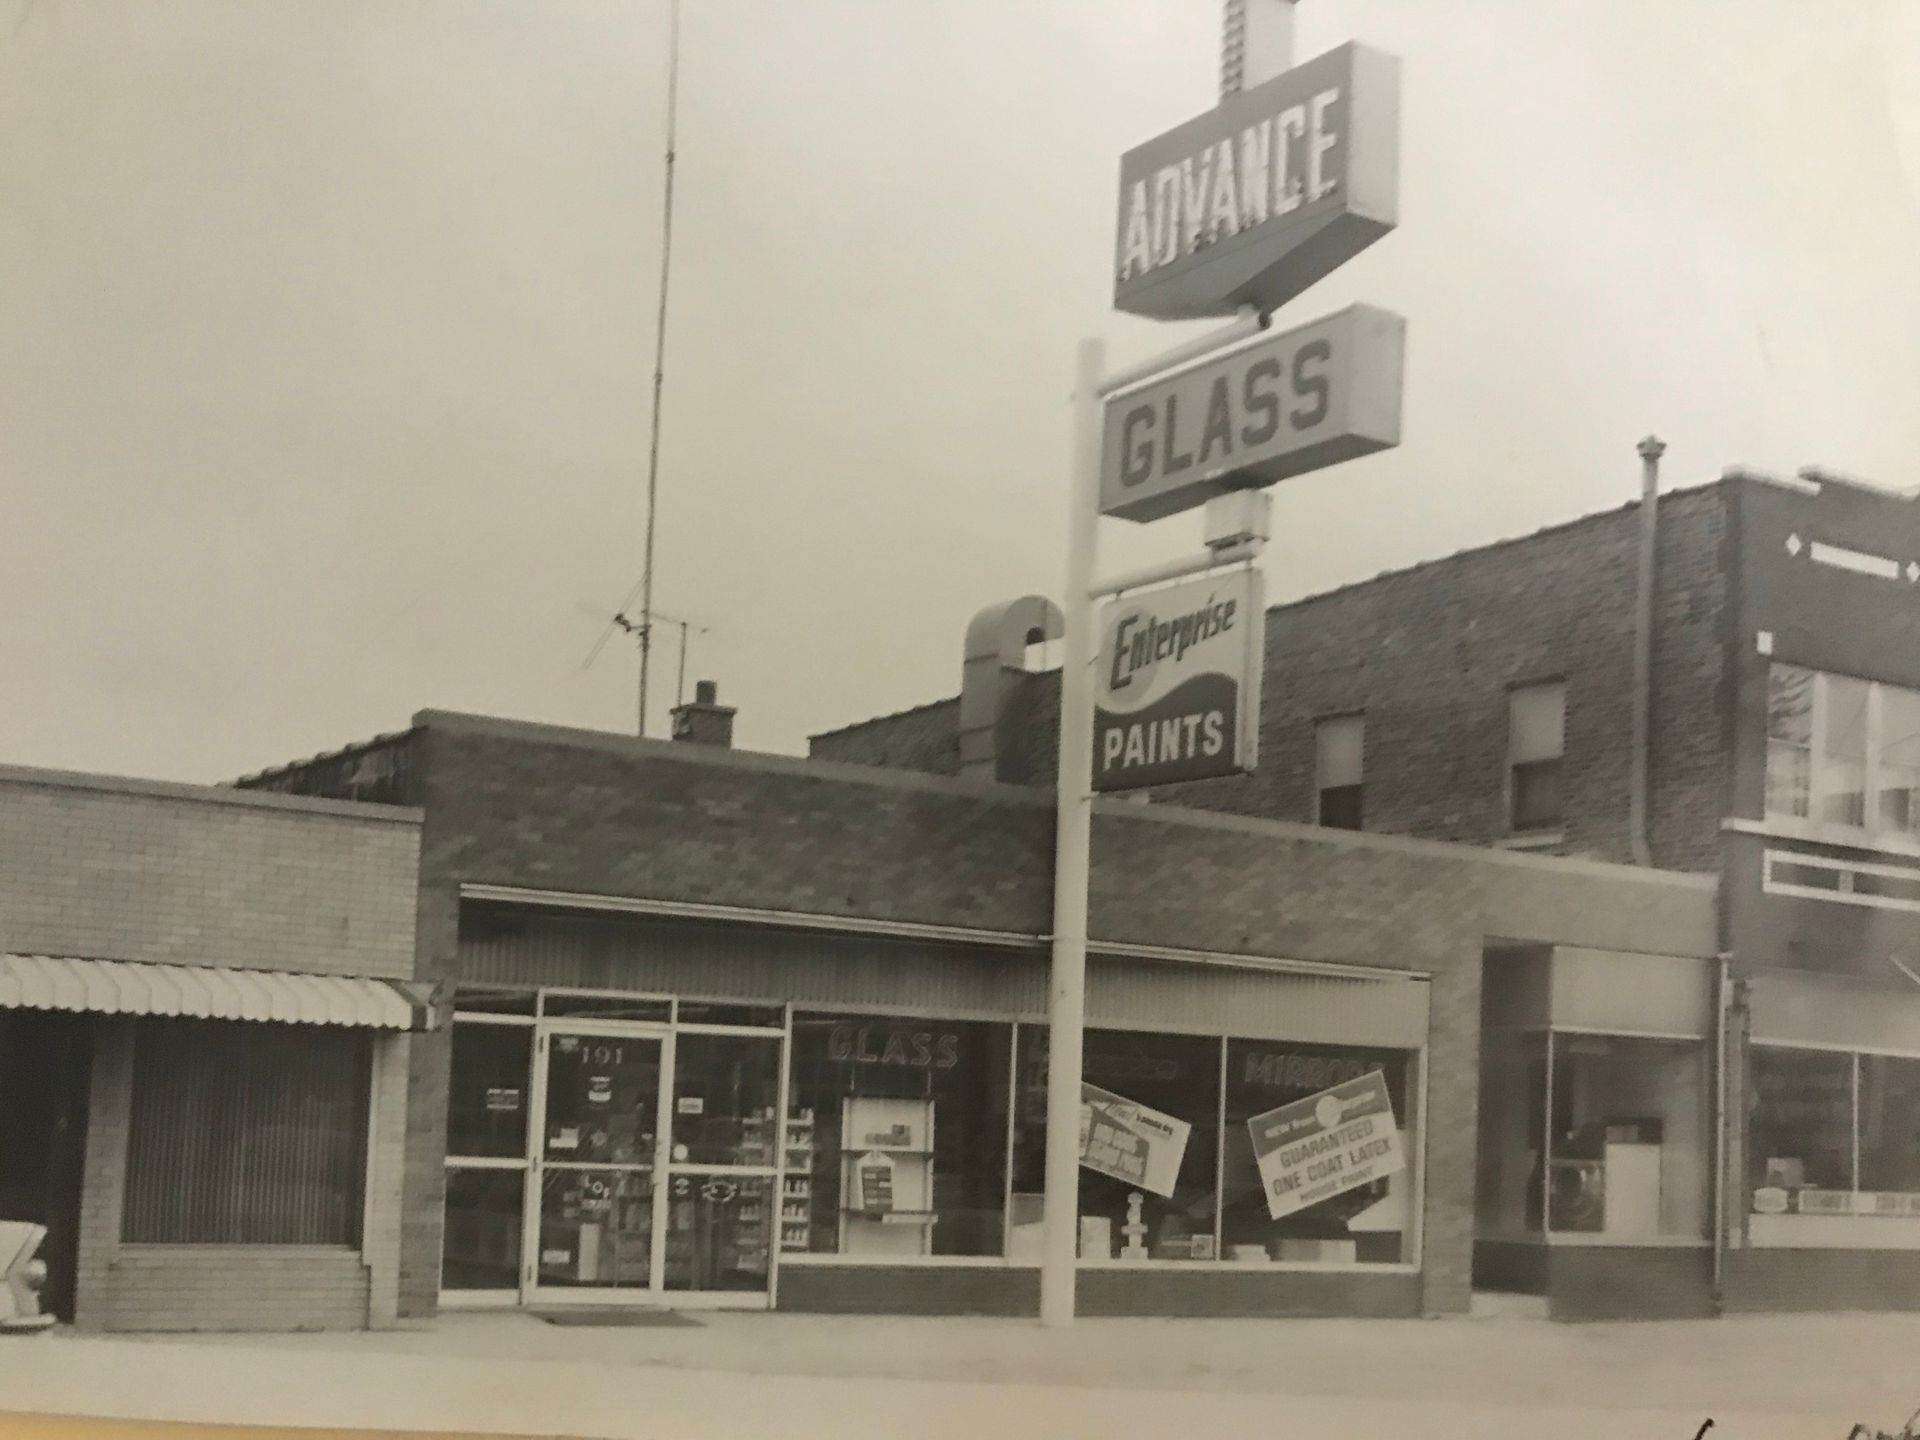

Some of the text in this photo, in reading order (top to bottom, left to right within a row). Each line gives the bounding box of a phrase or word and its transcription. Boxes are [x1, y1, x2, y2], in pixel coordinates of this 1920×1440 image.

[1117, 87, 1340, 282] ADVANCE
[1120, 338, 1331, 487] GLASS
[1110, 591, 1237, 690] Enterprise
[1103, 710, 1224, 772] PAINTS
[582, 1046, 623, 1065] 191
[828, 1024, 959, 1068] GLASS
[1272, 1170, 1304, 1197] ONE
[1307, 1153, 1344, 1182] COAT
[1349, 1137, 1392, 1166] LATEX
[1279, 1119, 1374, 1168] GUARANTEED
